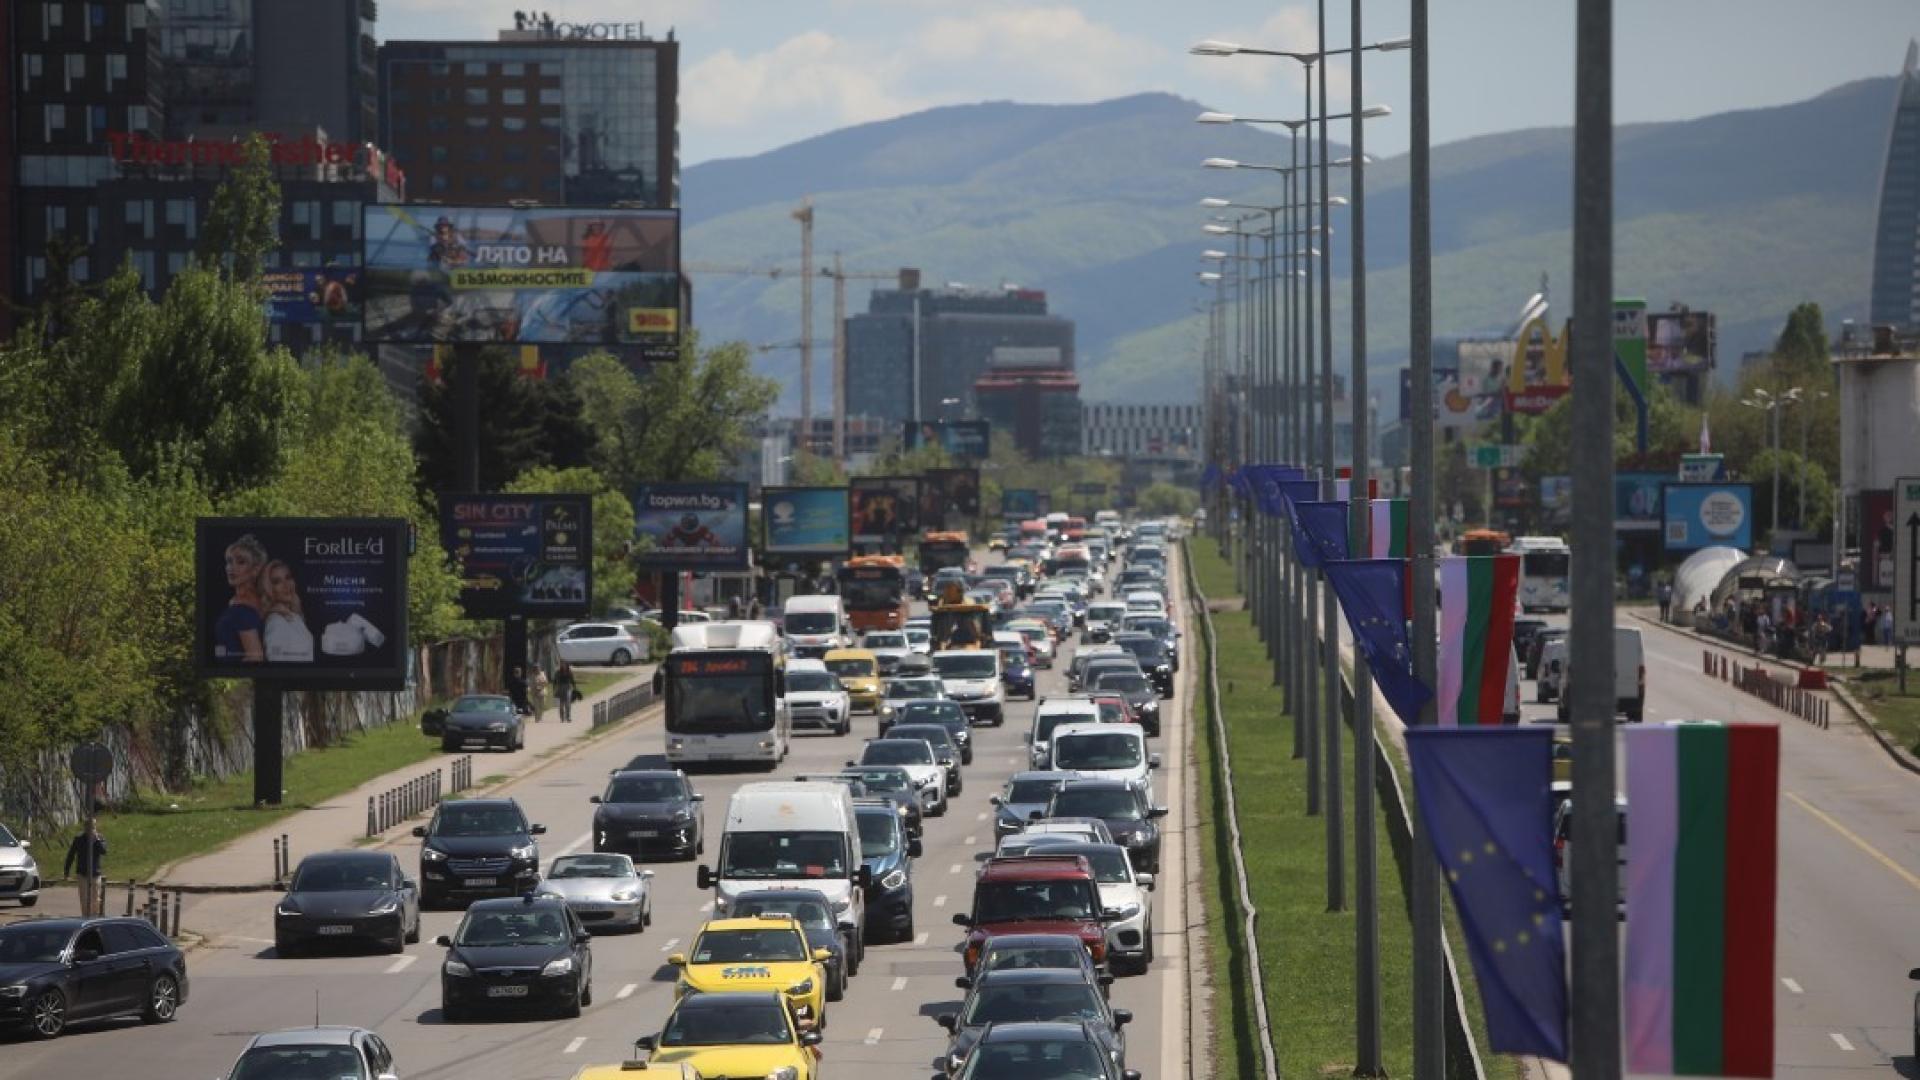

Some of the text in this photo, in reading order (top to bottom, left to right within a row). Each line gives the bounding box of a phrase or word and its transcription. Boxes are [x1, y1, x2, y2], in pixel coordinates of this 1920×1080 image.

[475, 246, 568, 264] ЛЯТО НА
[456, 272, 586, 286] ВЪЗМОЖНОСТИТЕ
[650, 494, 720, 509] topwin.bg
[454, 503, 535, 520] SIN CITY
